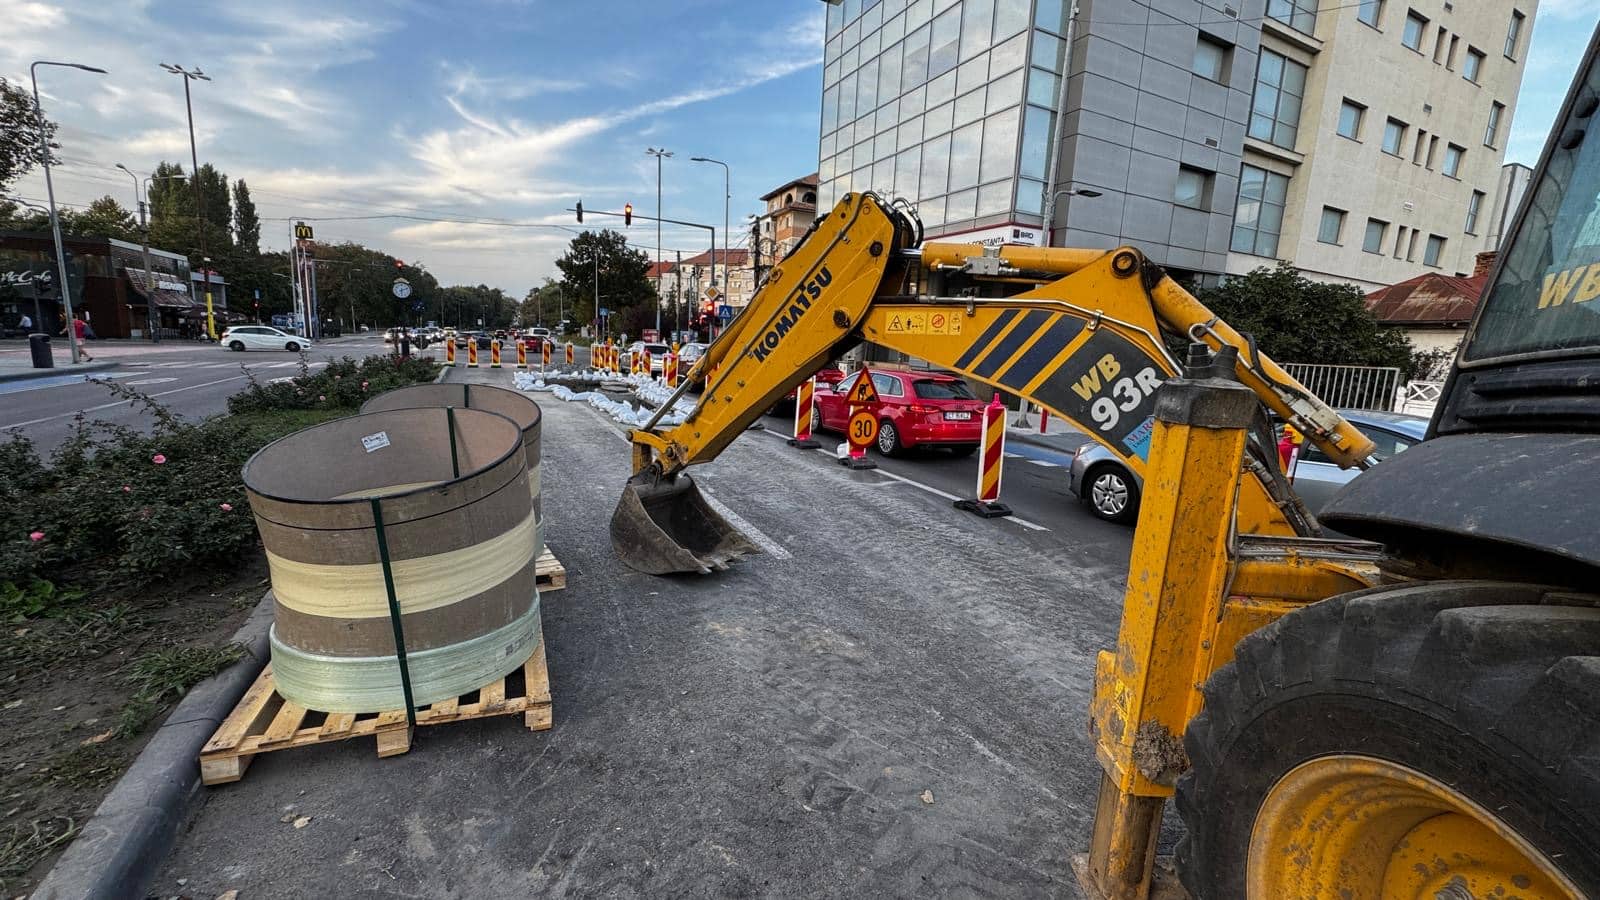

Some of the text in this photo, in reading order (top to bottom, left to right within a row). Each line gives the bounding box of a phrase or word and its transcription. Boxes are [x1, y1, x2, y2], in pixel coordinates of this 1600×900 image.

[1021, 231, 1034, 239] BRD
[753, 266, 832, 363] KOMATSU
[1071, 353, 1121, 401] WB
[1091, 367, 1163, 431] 93R
[854, 419, 872, 438] 30
